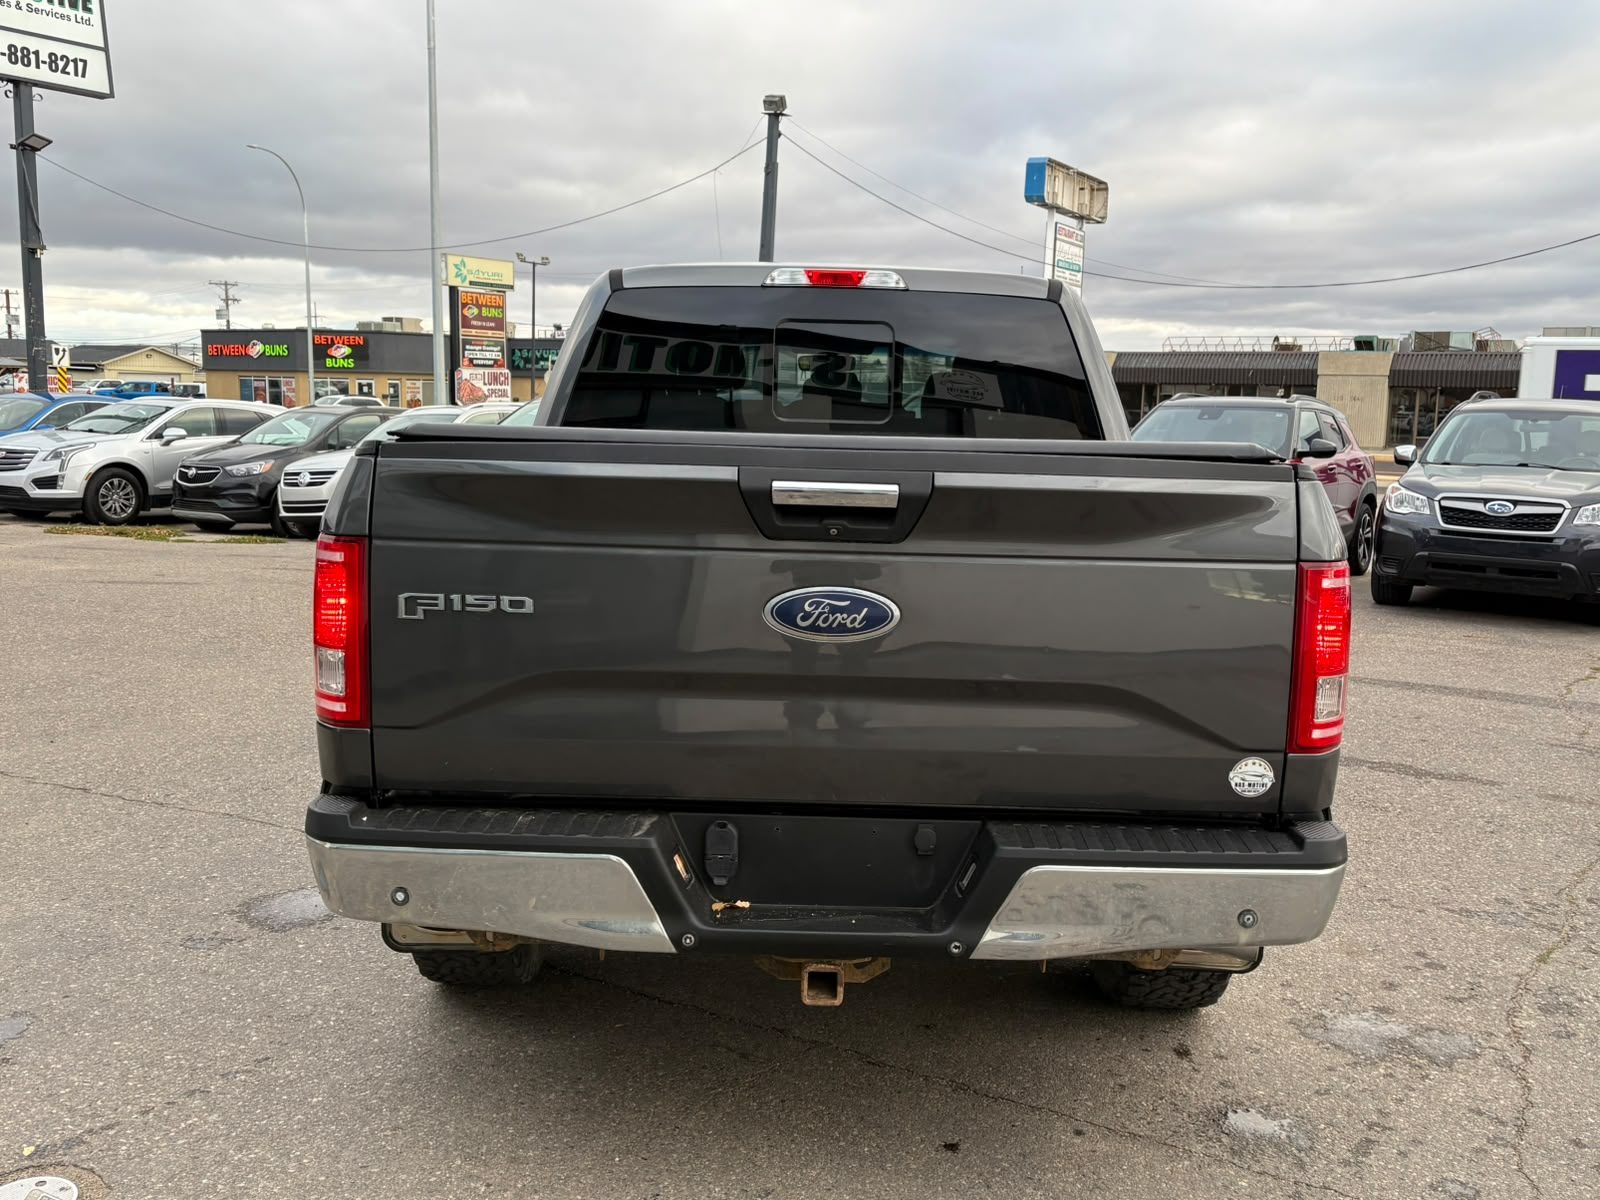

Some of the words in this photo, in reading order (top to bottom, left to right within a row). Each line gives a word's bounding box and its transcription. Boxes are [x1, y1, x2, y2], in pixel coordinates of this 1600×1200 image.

[15, 1, 23, 11] &
[26, 3, 72, 22] Services
[75, 14, 94, 27] Ltd.
[461, 292, 503, 307] BETWEEN
[482, 307, 503, 318] BUNS
[314, 335, 364, 345] BETWEEN
[208, 344, 246, 356] BETWEEN
[265, 344, 288, 357] BUNS
[325, 358, 355, 368] BUNS
[483, 371, 509, 386] LUNCH
[487, 388, 509, 399] SPECIAL
[796, 597, 869, 629] Ford
